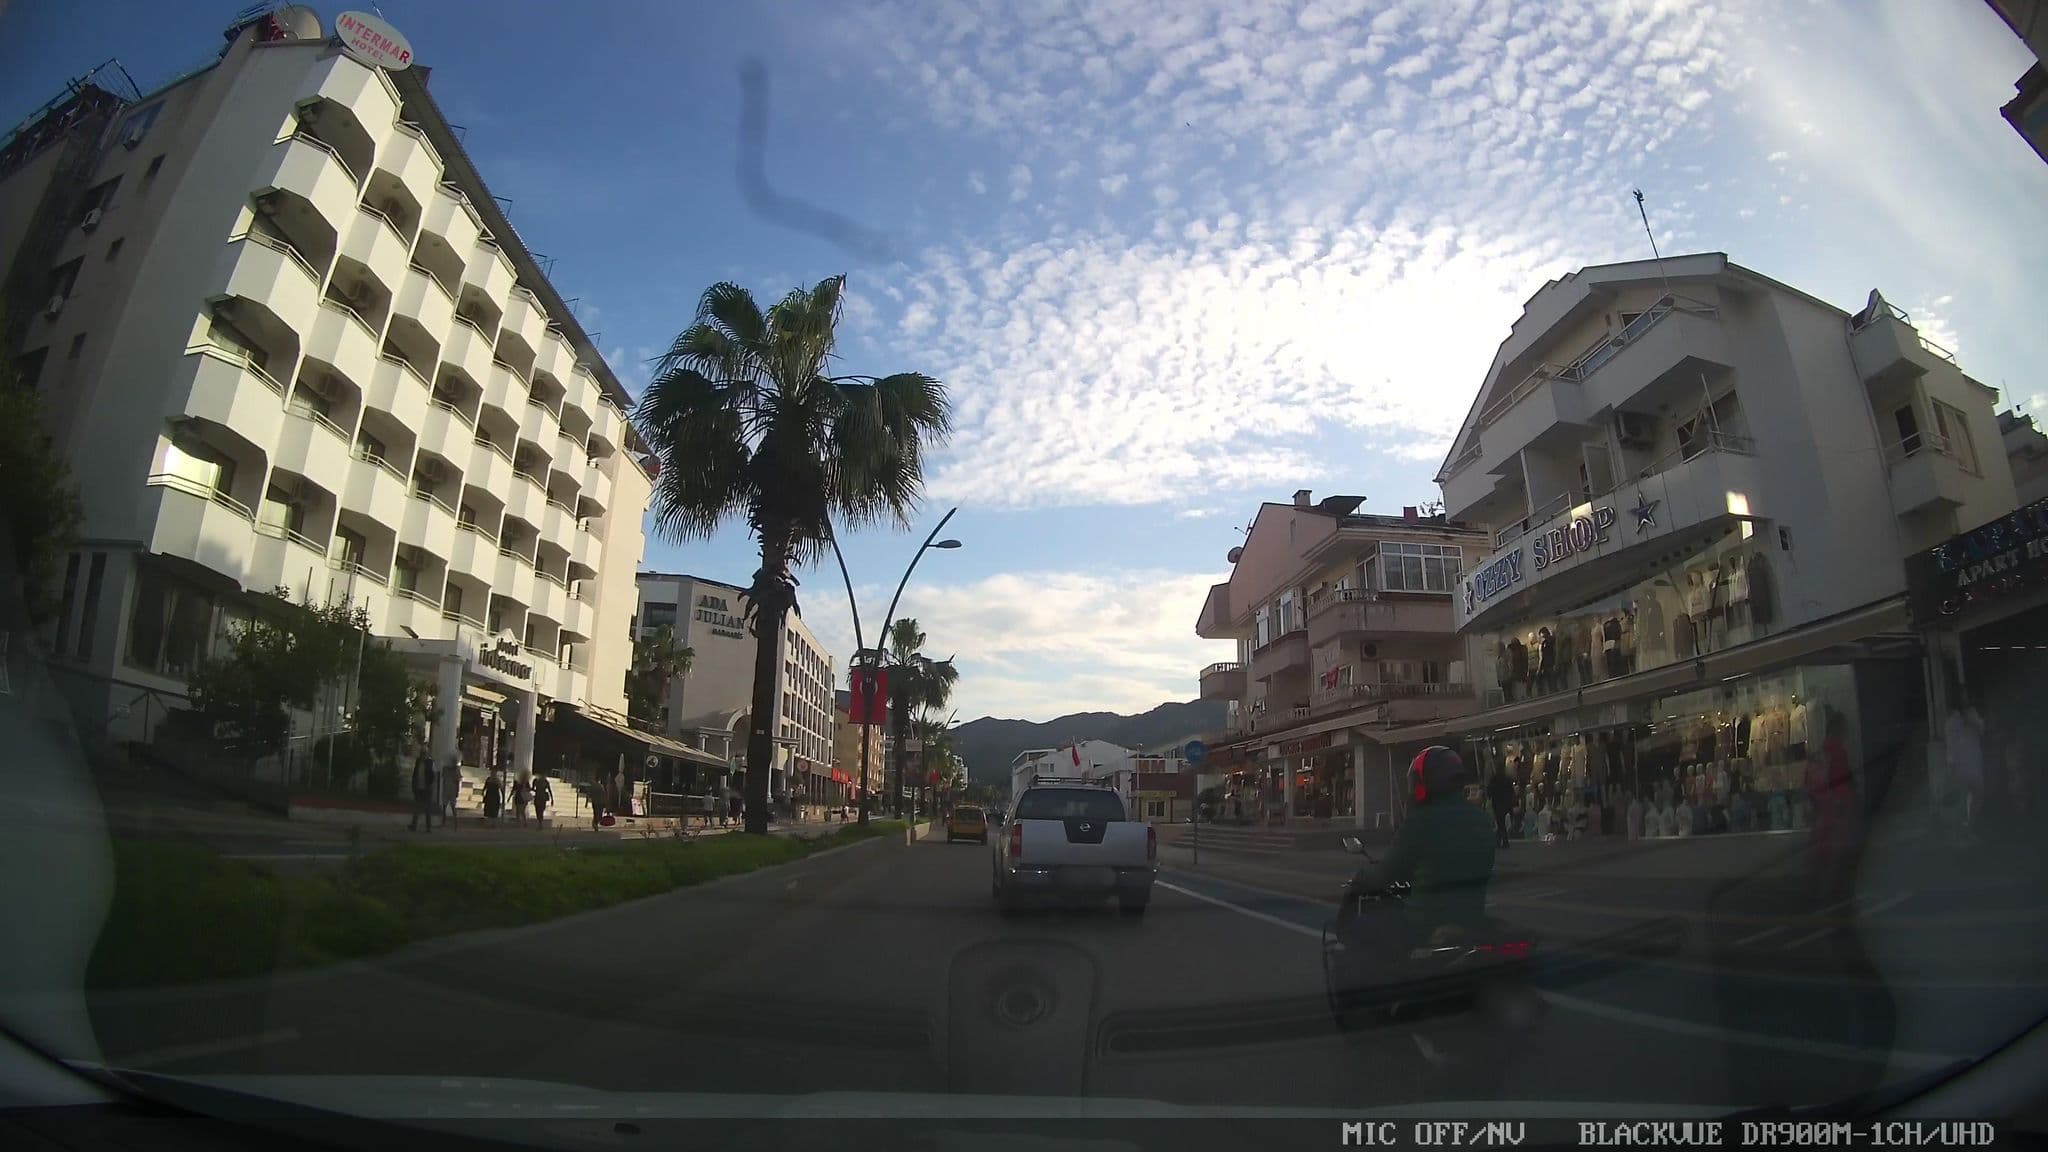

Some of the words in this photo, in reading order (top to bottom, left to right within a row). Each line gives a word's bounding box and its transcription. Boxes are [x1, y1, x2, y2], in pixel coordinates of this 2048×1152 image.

[339, 14, 410, 63] INTERMAR
[350, 37, 385, 62] HOTEL
[1474, 547, 1522, 603] OZZY
[1532, 505, 1616, 571] SHOP
[1957, 547, 2019, 587] APART
[694, 608, 744, 630] JULIAN
[699, 594, 728, 612] ADA
